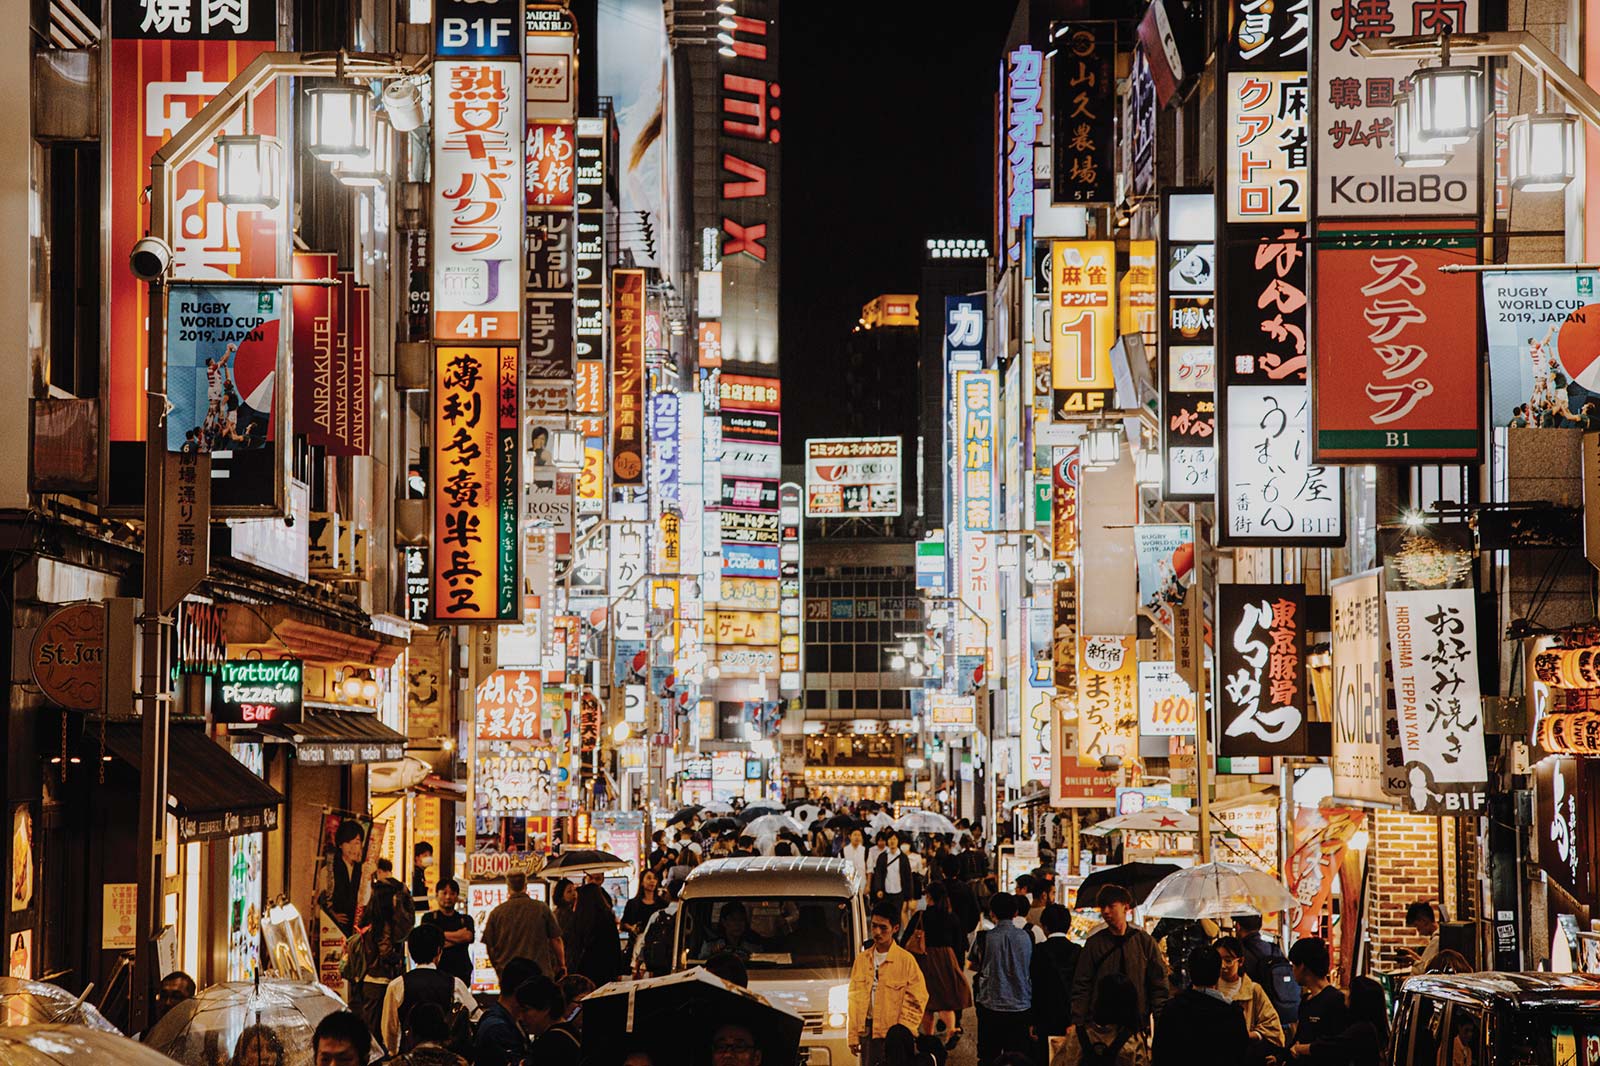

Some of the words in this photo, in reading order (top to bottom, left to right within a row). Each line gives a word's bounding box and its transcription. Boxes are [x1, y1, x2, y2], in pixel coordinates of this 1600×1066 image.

[443, 18, 512, 47] B1F
[1068, 62, 1098, 184] 山久農場
[1238, 78, 1273, 216] クアトロ
[442, 66, 515, 253] 熟女キャバクラ
[534, 193, 554, 204] 4F
[1330, 175, 1468, 204] KollaBo
[1062, 266, 1107, 286] 麻雀
[1063, 293, 1106, 304] ナンバー
[1497, 287, 1548, 298] RUGBY
[180, 302, 232, 315] RUGBY
[1499, 300, 1552, 310] WORLD
[1555, 300, 1585, 310] CUP
[181, 316, 234, 329] WORLD
[235, 316, 265, 329] CUP
[456, 313, 498, 338] 4F
[1499, 312, 1536, 324] 2019,
[1538, 312, 1586, 324] JAPAN
[179, 330, 217, 344] 2019,
[217, 330, 265, 343] JAPAN
[531, 301, 556, 358] エデン
[1360, 255, 1434, 425] ステップ
[1062, 311, 1095, 382] 1
[313, 316, 330, 428] ANRAKUTEI
[719, 383, 777, 403] 全店営業中
[1063, 392, 1104, 411] 4F
[1385, 431, 1411, 448] B1
[1235, 482, 1252, 534] 一番街
[1302, 518, 1337, 533] B1F
[665, 517, 678, 559] 麻雀
[971, 536, 987, 610] マンボー
[719, 622, 756, 638] ゲーム
[1395, 606, 1414, 669] HIROSHIMA
[1087, 643, 1121, 662] 新宿
[1269, 599, 1297, 705] 東京豚骨
[221, 661, 299, 683] Trattoria
[1099, 661, 1111, 670] の
[222, 682, 295, 704] Pizzeria
[1421, 604, 1477, 763] お好み焼き
[240, 703, 275, 721] Bar
[1065, 776, 1091, 786] ONLINE
[1445, 792, 1486, 810] B1F
[471, 853, 509, 875] 19:00
